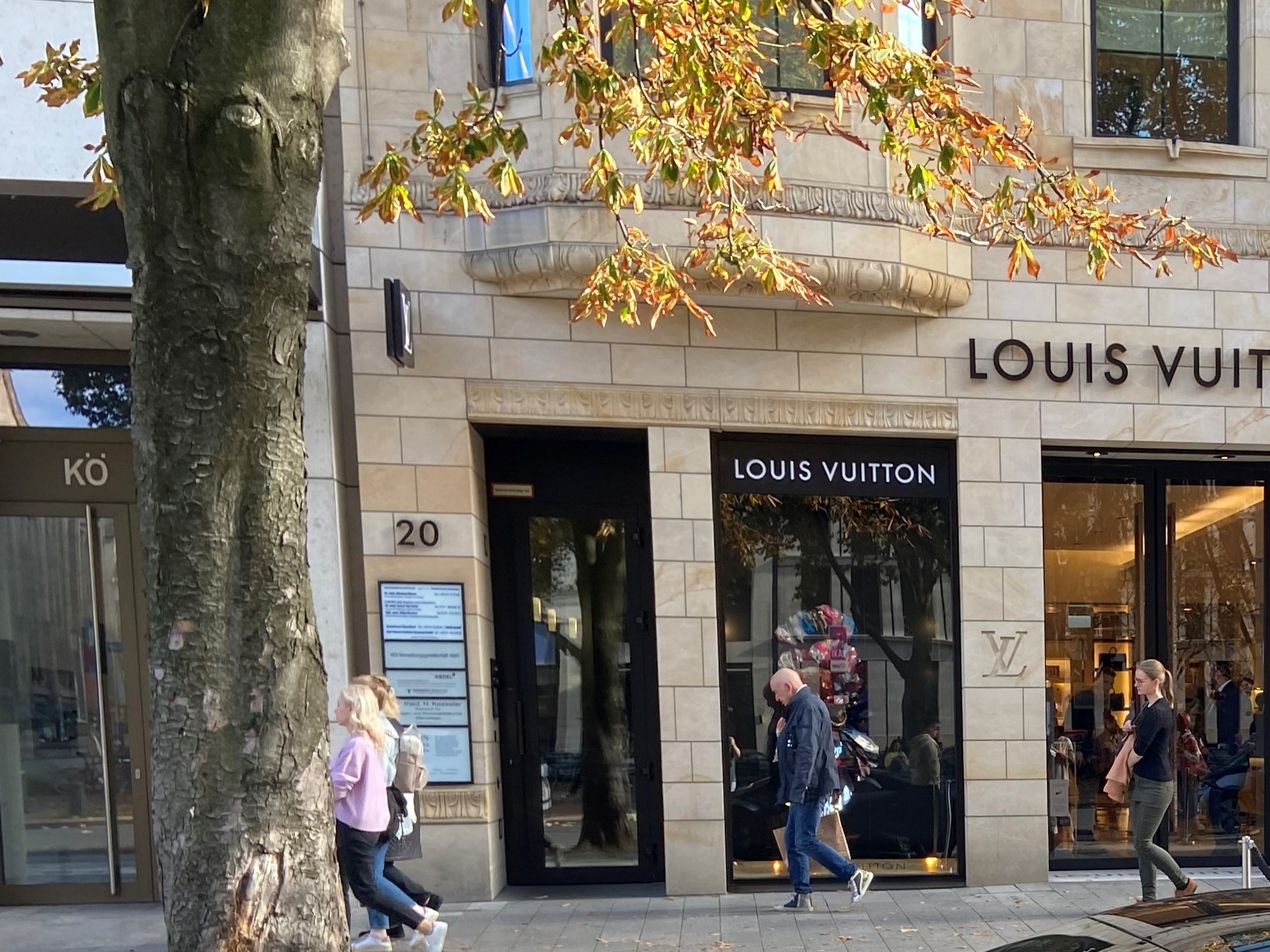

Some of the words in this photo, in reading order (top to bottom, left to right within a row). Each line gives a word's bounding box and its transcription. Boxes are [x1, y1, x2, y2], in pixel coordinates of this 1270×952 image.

[969, 338, 1128, 386] LOUIS
[64, 452, 109, 487] KÖ
[734, 458, 812, 481] LOUIS
[821, 461, 936, 485] VUITTON
[396, 519, 440, 547] 20
